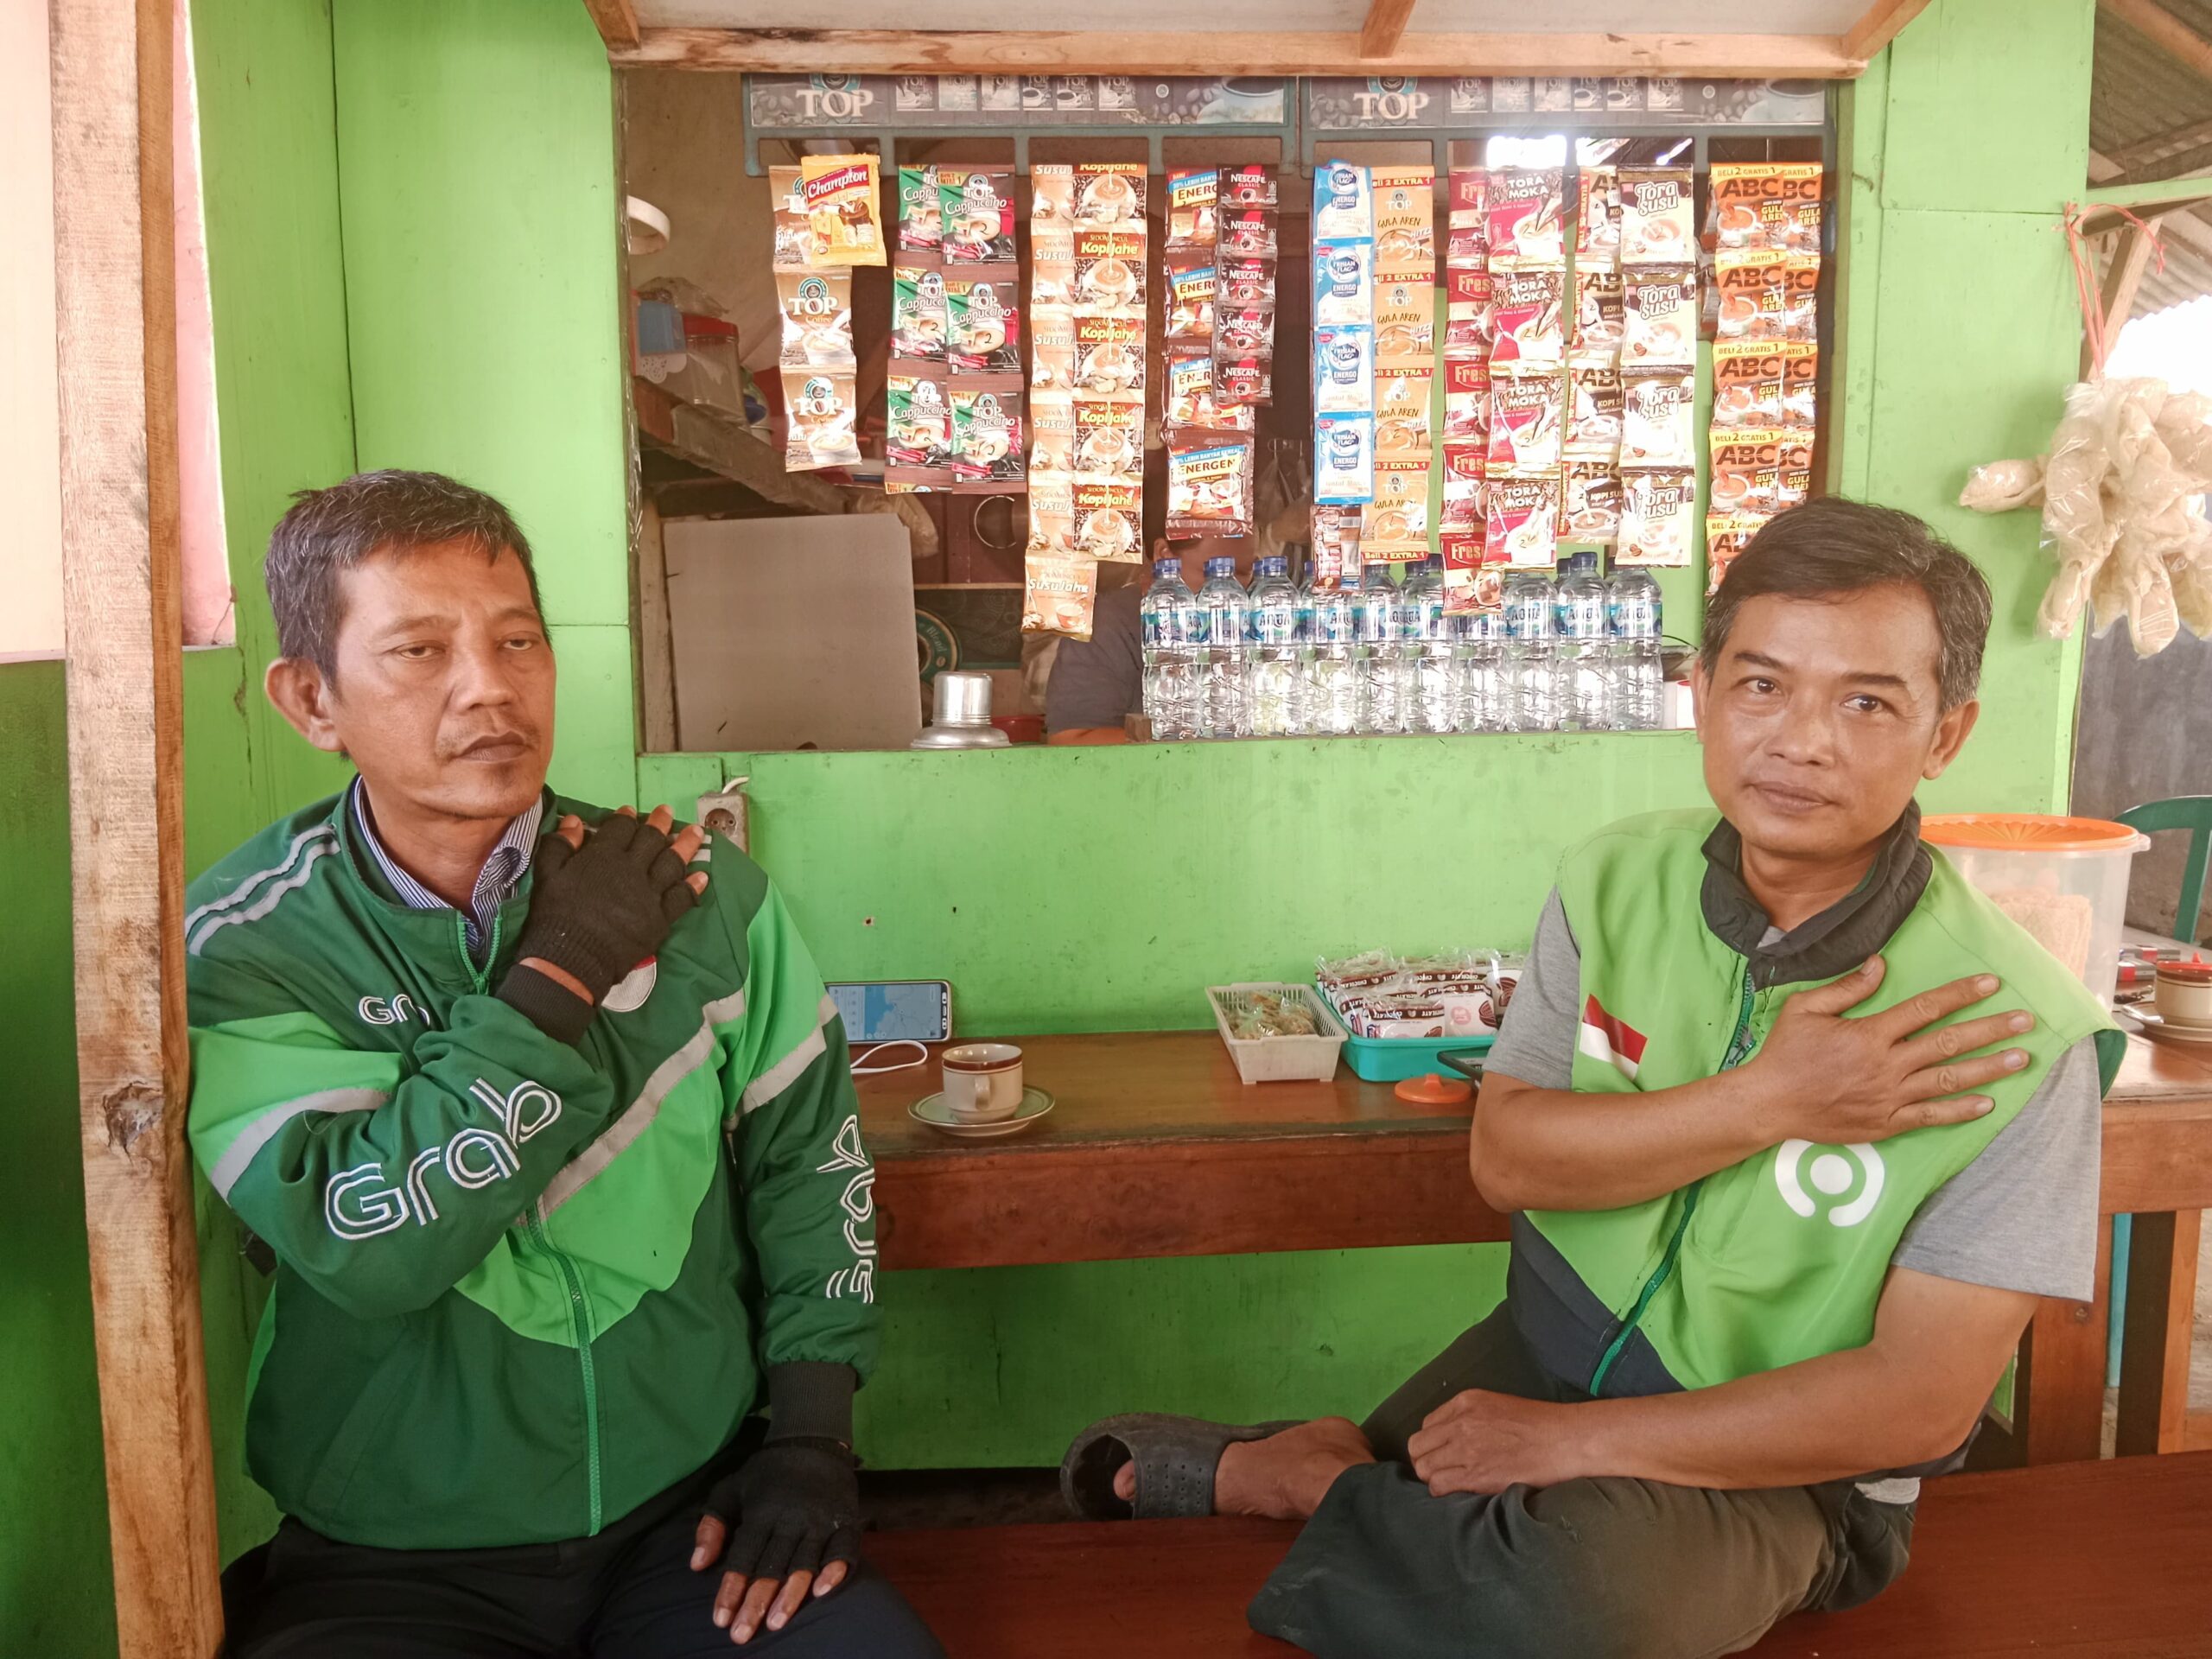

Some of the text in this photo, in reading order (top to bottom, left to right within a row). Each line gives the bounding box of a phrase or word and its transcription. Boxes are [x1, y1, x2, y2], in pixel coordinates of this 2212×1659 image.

[796, 89, 874, 118] TOP
[1353, 92, 1429, 120] TOP
[1735, 167, 1741, 175] 2
[808, 168, 868, 199] Champion
[1393, 177, 1423, 186] EXTRA
[1508, 176, 1545, 188] TORA
[1720, 178, 1779, 199] ABC
[1783, 180, 1817, 200] BC
[903, 187, 938, 201] Cappu
[963, 186, 995, 200] TOP
[1508, 186, 1549, 199] MOKA
[1635, 181, 1678, 203] Tora
[944, 198, 1007, 215] Cappuccino
[1386, 200, 1413, 211] TOP
[1377, 216, 1421, 228] GULA AREN
[1459, 275, 1491, 292] Fres
[1584, 272, 1621, 293] AB
[1723, 265, 1782, 288] ABC
[1784, 270, 1814, 290] BC
[1509, 279, 1547, 293] TORA
[969, 296, 998, 308] TOP
[1510, 290, 1552, 304] MOKA
[1637, 284, 1681, 306] Tora
[788, 297, 838, 315] TOP
[951, 307, 1012, 326] Cappuccino
[1377, 313, 1421, 324] GULA AREN
[1737, 345, 1743, 353] 2
[1774, 343, 1778, 352] 1
[1455, 365, 1487, 383] Fres
[1719, 356, 1780, 378] ABC
[1579, 368, 1622, 387] AB
[1508, 384, 1547, 397] TORA
[794, 397, 843, 416] TOP
[1508, 395, 1549, 408] MOKA
[974, 406, 1002, 418] TOP
[1376, 408, 1419, 419] GULA AREN
[956, 416, 1016, 435] Cappuccino
[1732, 432, 1738, 442] 2
[1453, 455, 1484, 472] Fres
[1716, 444, 1776, 466] ABC
[1505, 485, 1541, 497] TORA
[1375, 499, 1393, 510] GULA
[1729, 520, 1735, 529] 2
[1452, 543, 1484, 560] Fres
[325, 1077, 562, 1240] Grab
[816, 1115, 878, 1305] Grab
